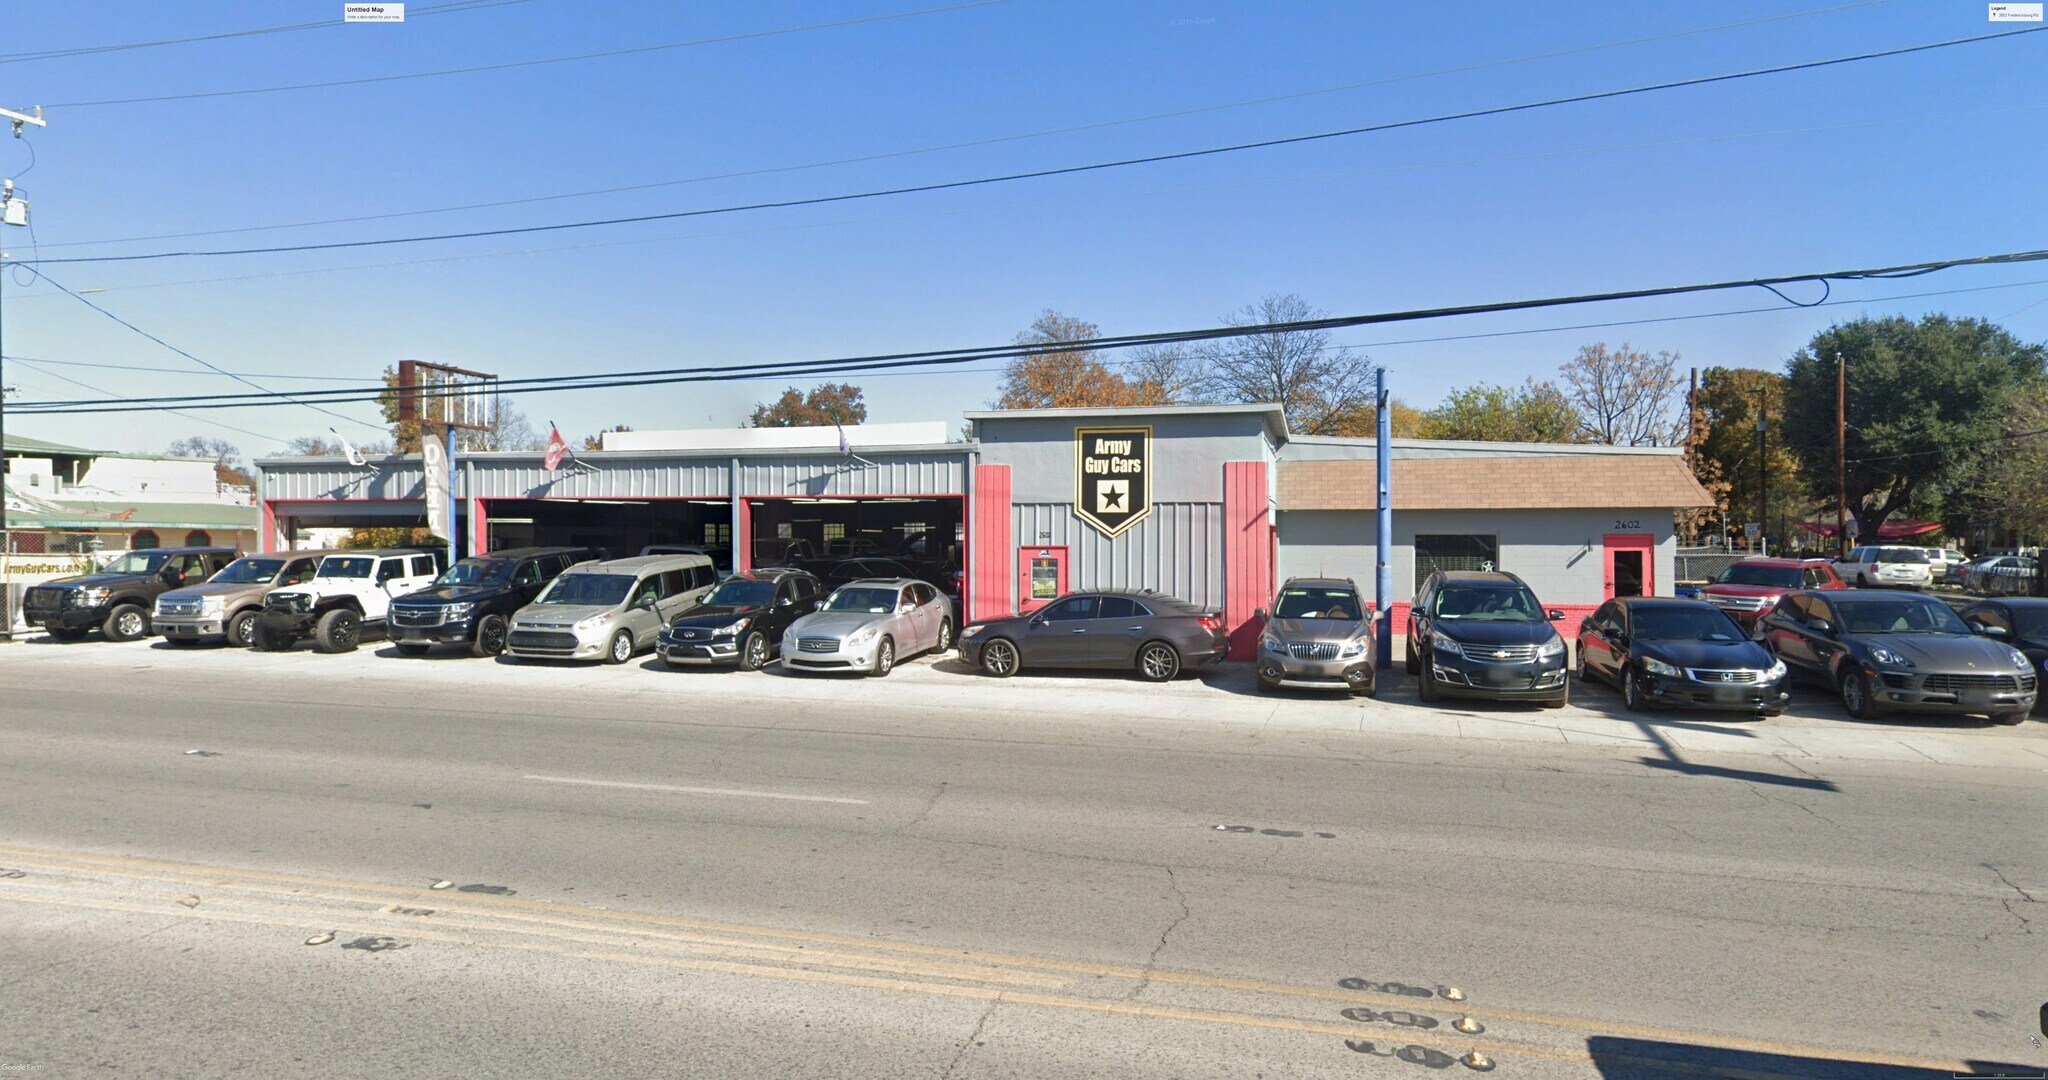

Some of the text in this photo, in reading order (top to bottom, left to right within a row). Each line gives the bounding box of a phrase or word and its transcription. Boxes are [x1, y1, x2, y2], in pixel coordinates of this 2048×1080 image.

[1095, 438, 1131, 456] Army
[1085, 456, 1141, 475] Guy Cars
[1614, 520, 1641, 529] 2602
